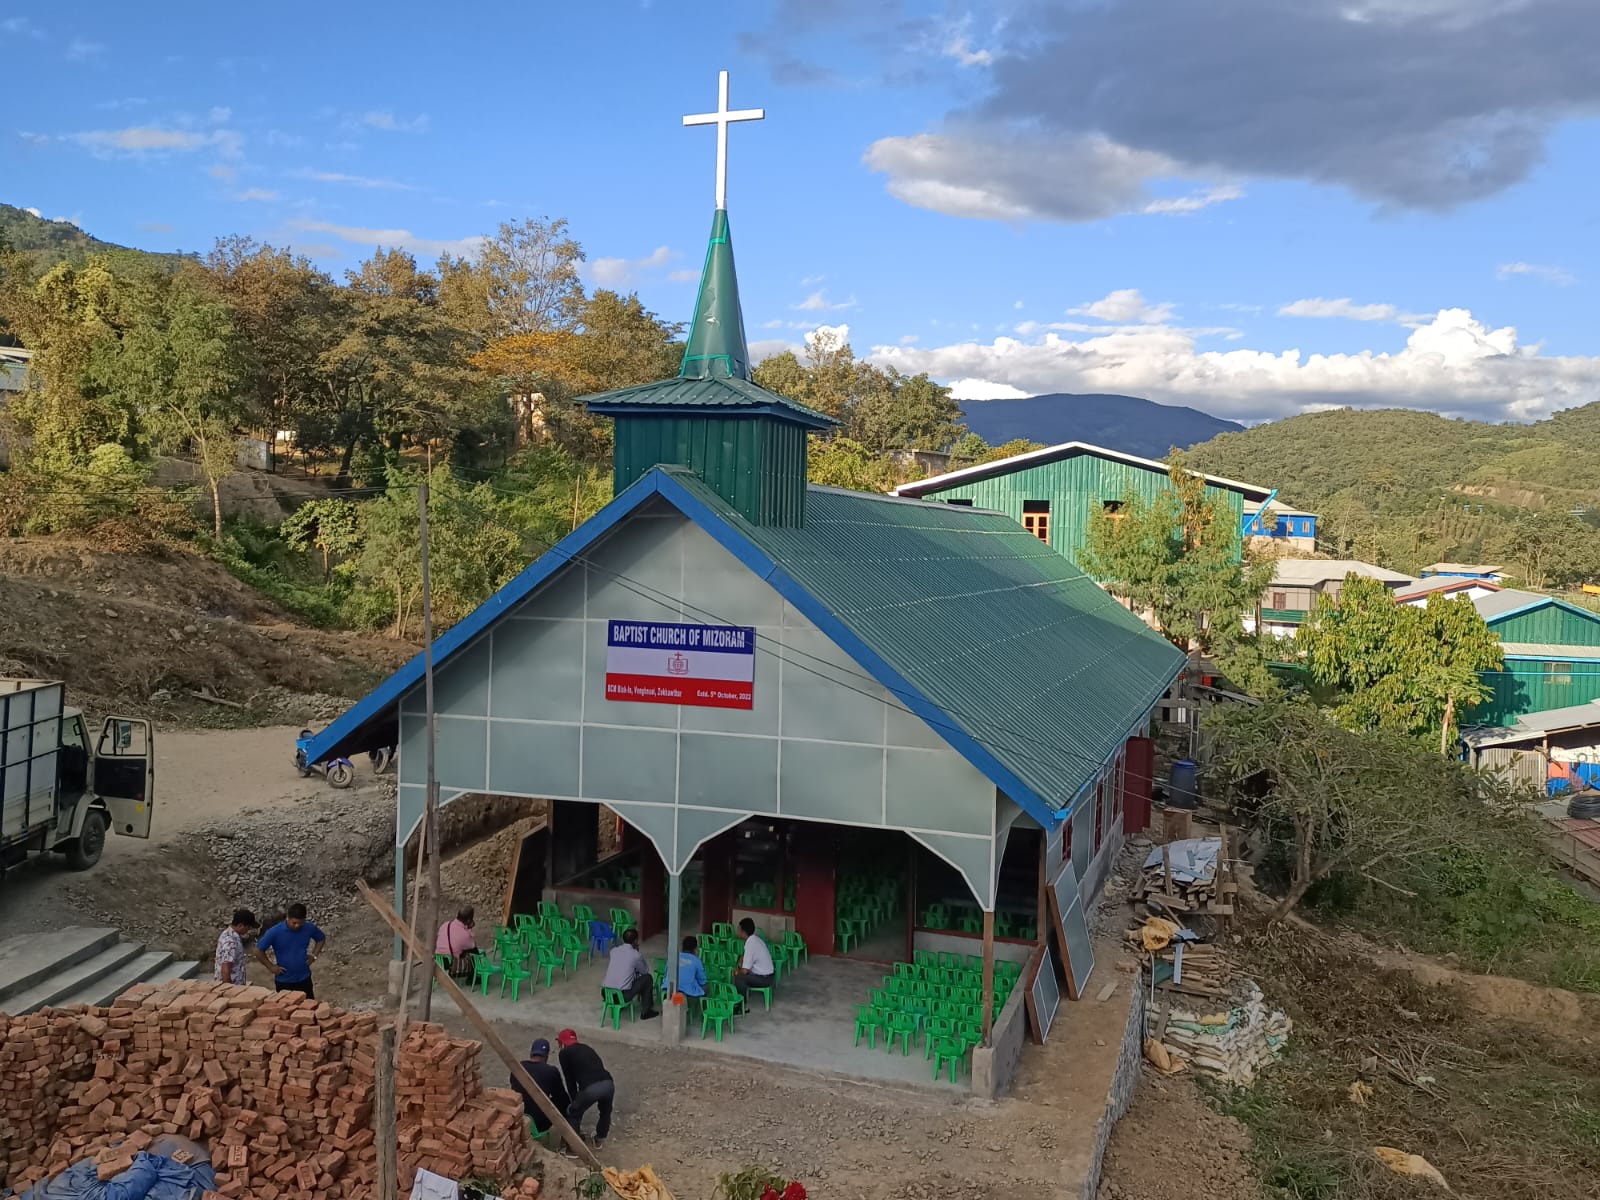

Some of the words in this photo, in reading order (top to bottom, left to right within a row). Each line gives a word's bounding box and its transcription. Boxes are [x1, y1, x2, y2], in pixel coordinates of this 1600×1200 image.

[613, 625, 649, 643] BAPTIST
[650, 627, 686, 645] CHURCH
[688, 629, 700, 646] OF
[702, 630, 746, 648] MIZORAM
